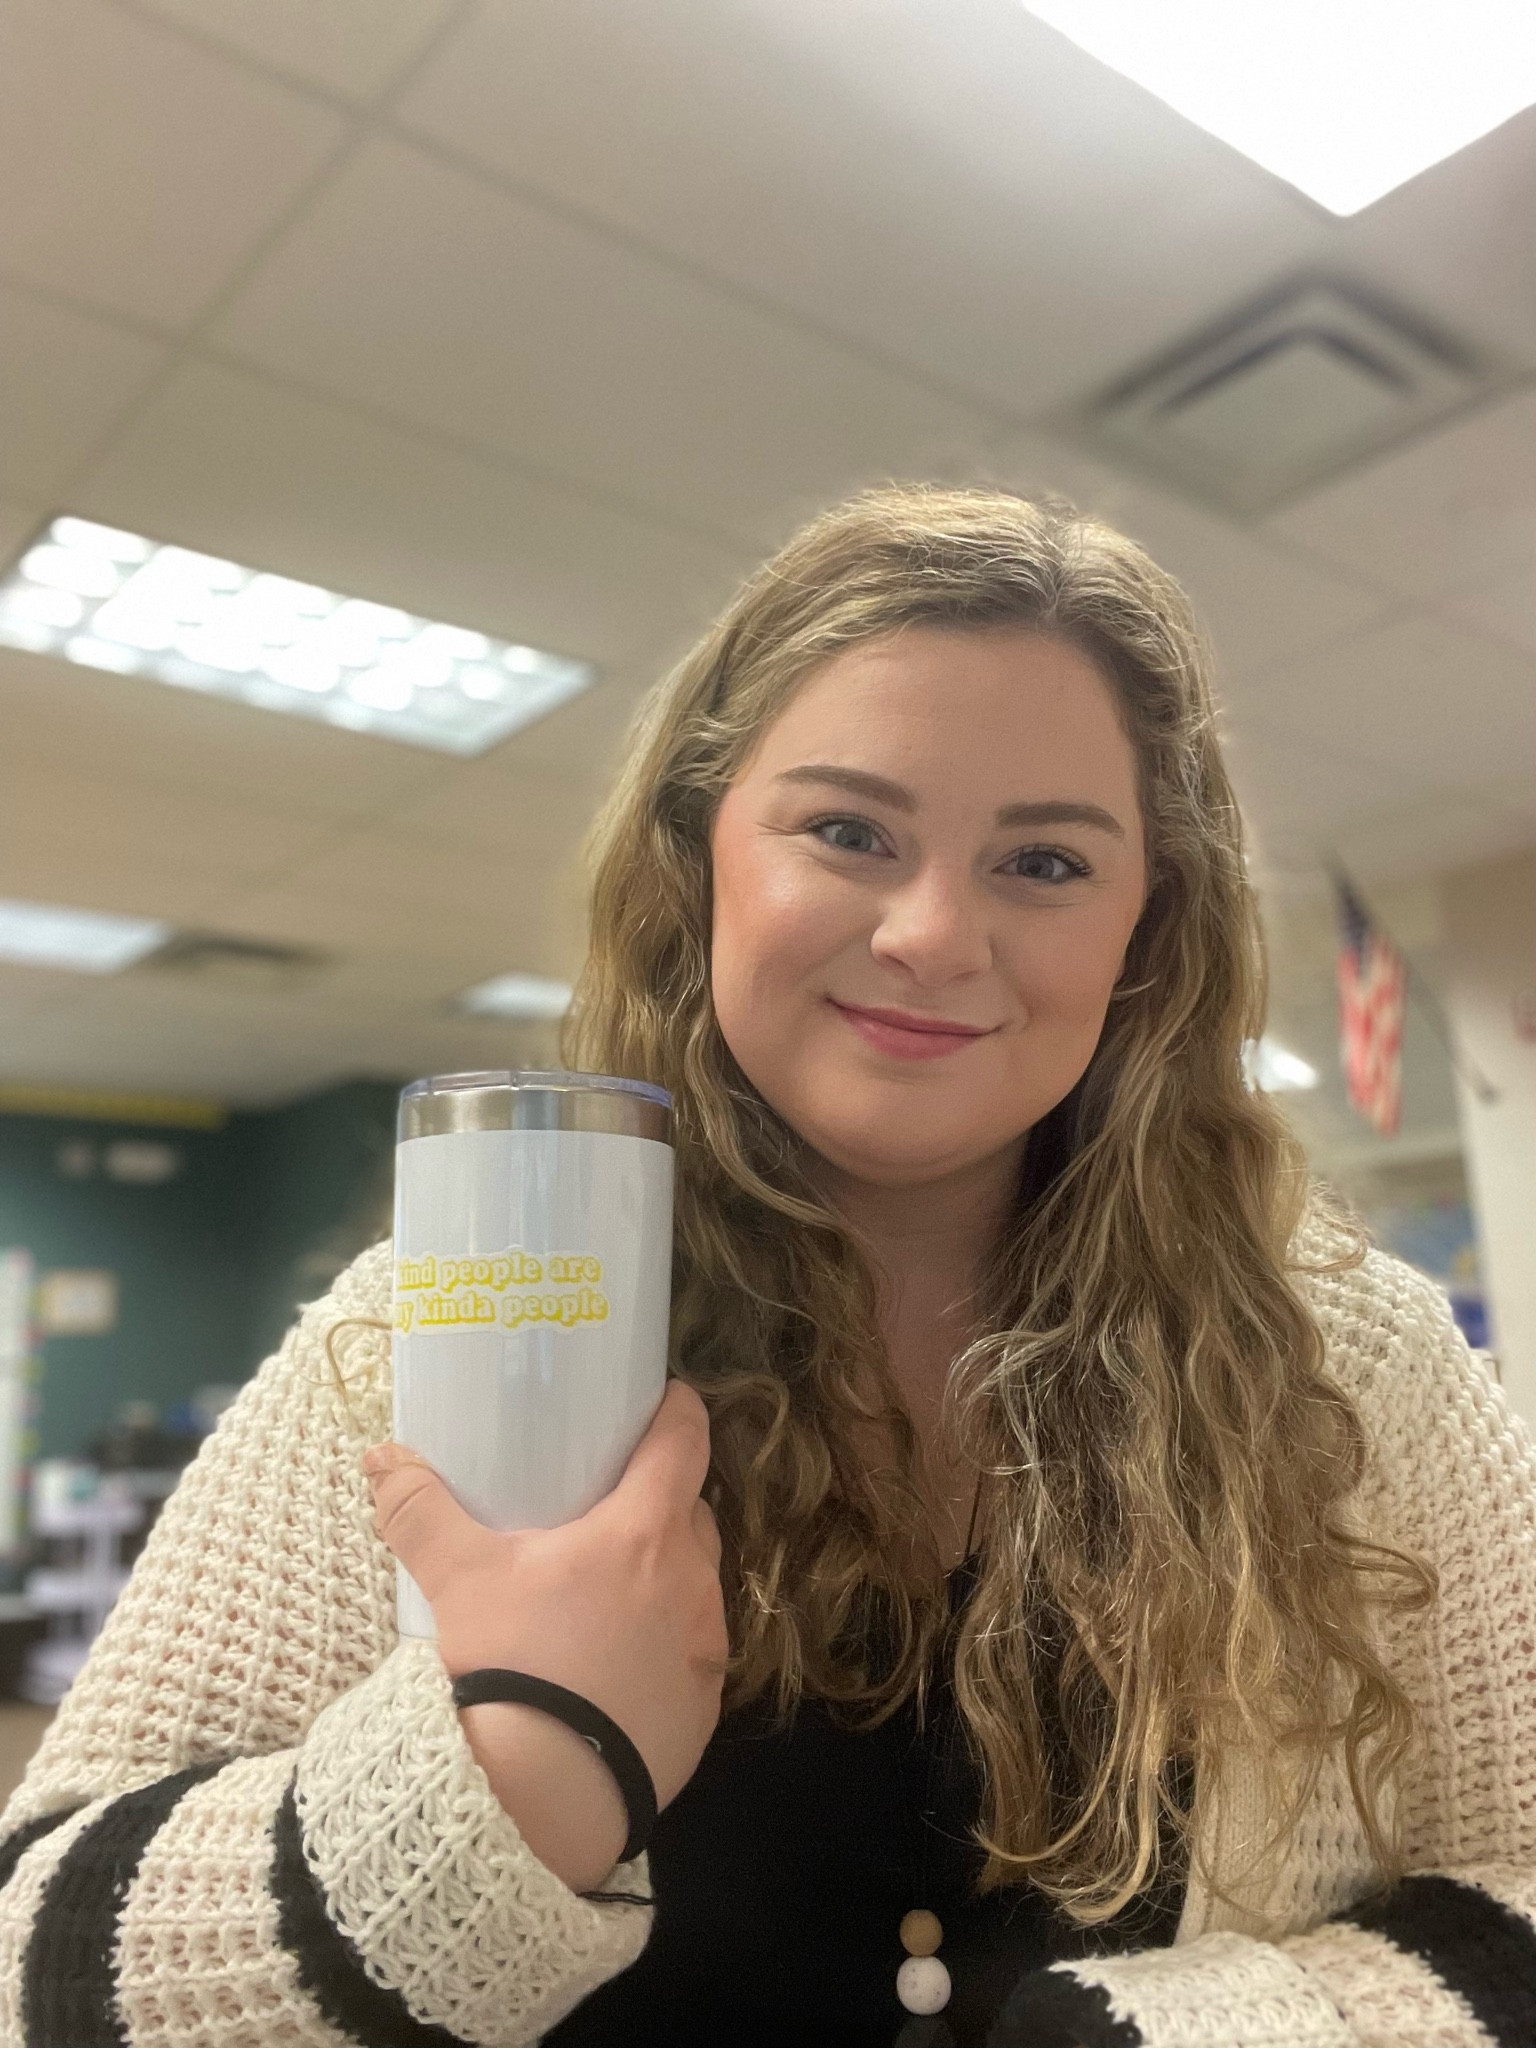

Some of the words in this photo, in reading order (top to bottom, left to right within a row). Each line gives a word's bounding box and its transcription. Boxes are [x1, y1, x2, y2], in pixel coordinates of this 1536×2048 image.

[440, 1251, 543, 1293] people
[549, 1256, 602, 1284] are
[418, 1290, 496, 1325] kinda
[501, 1286, 609, 1328] people
